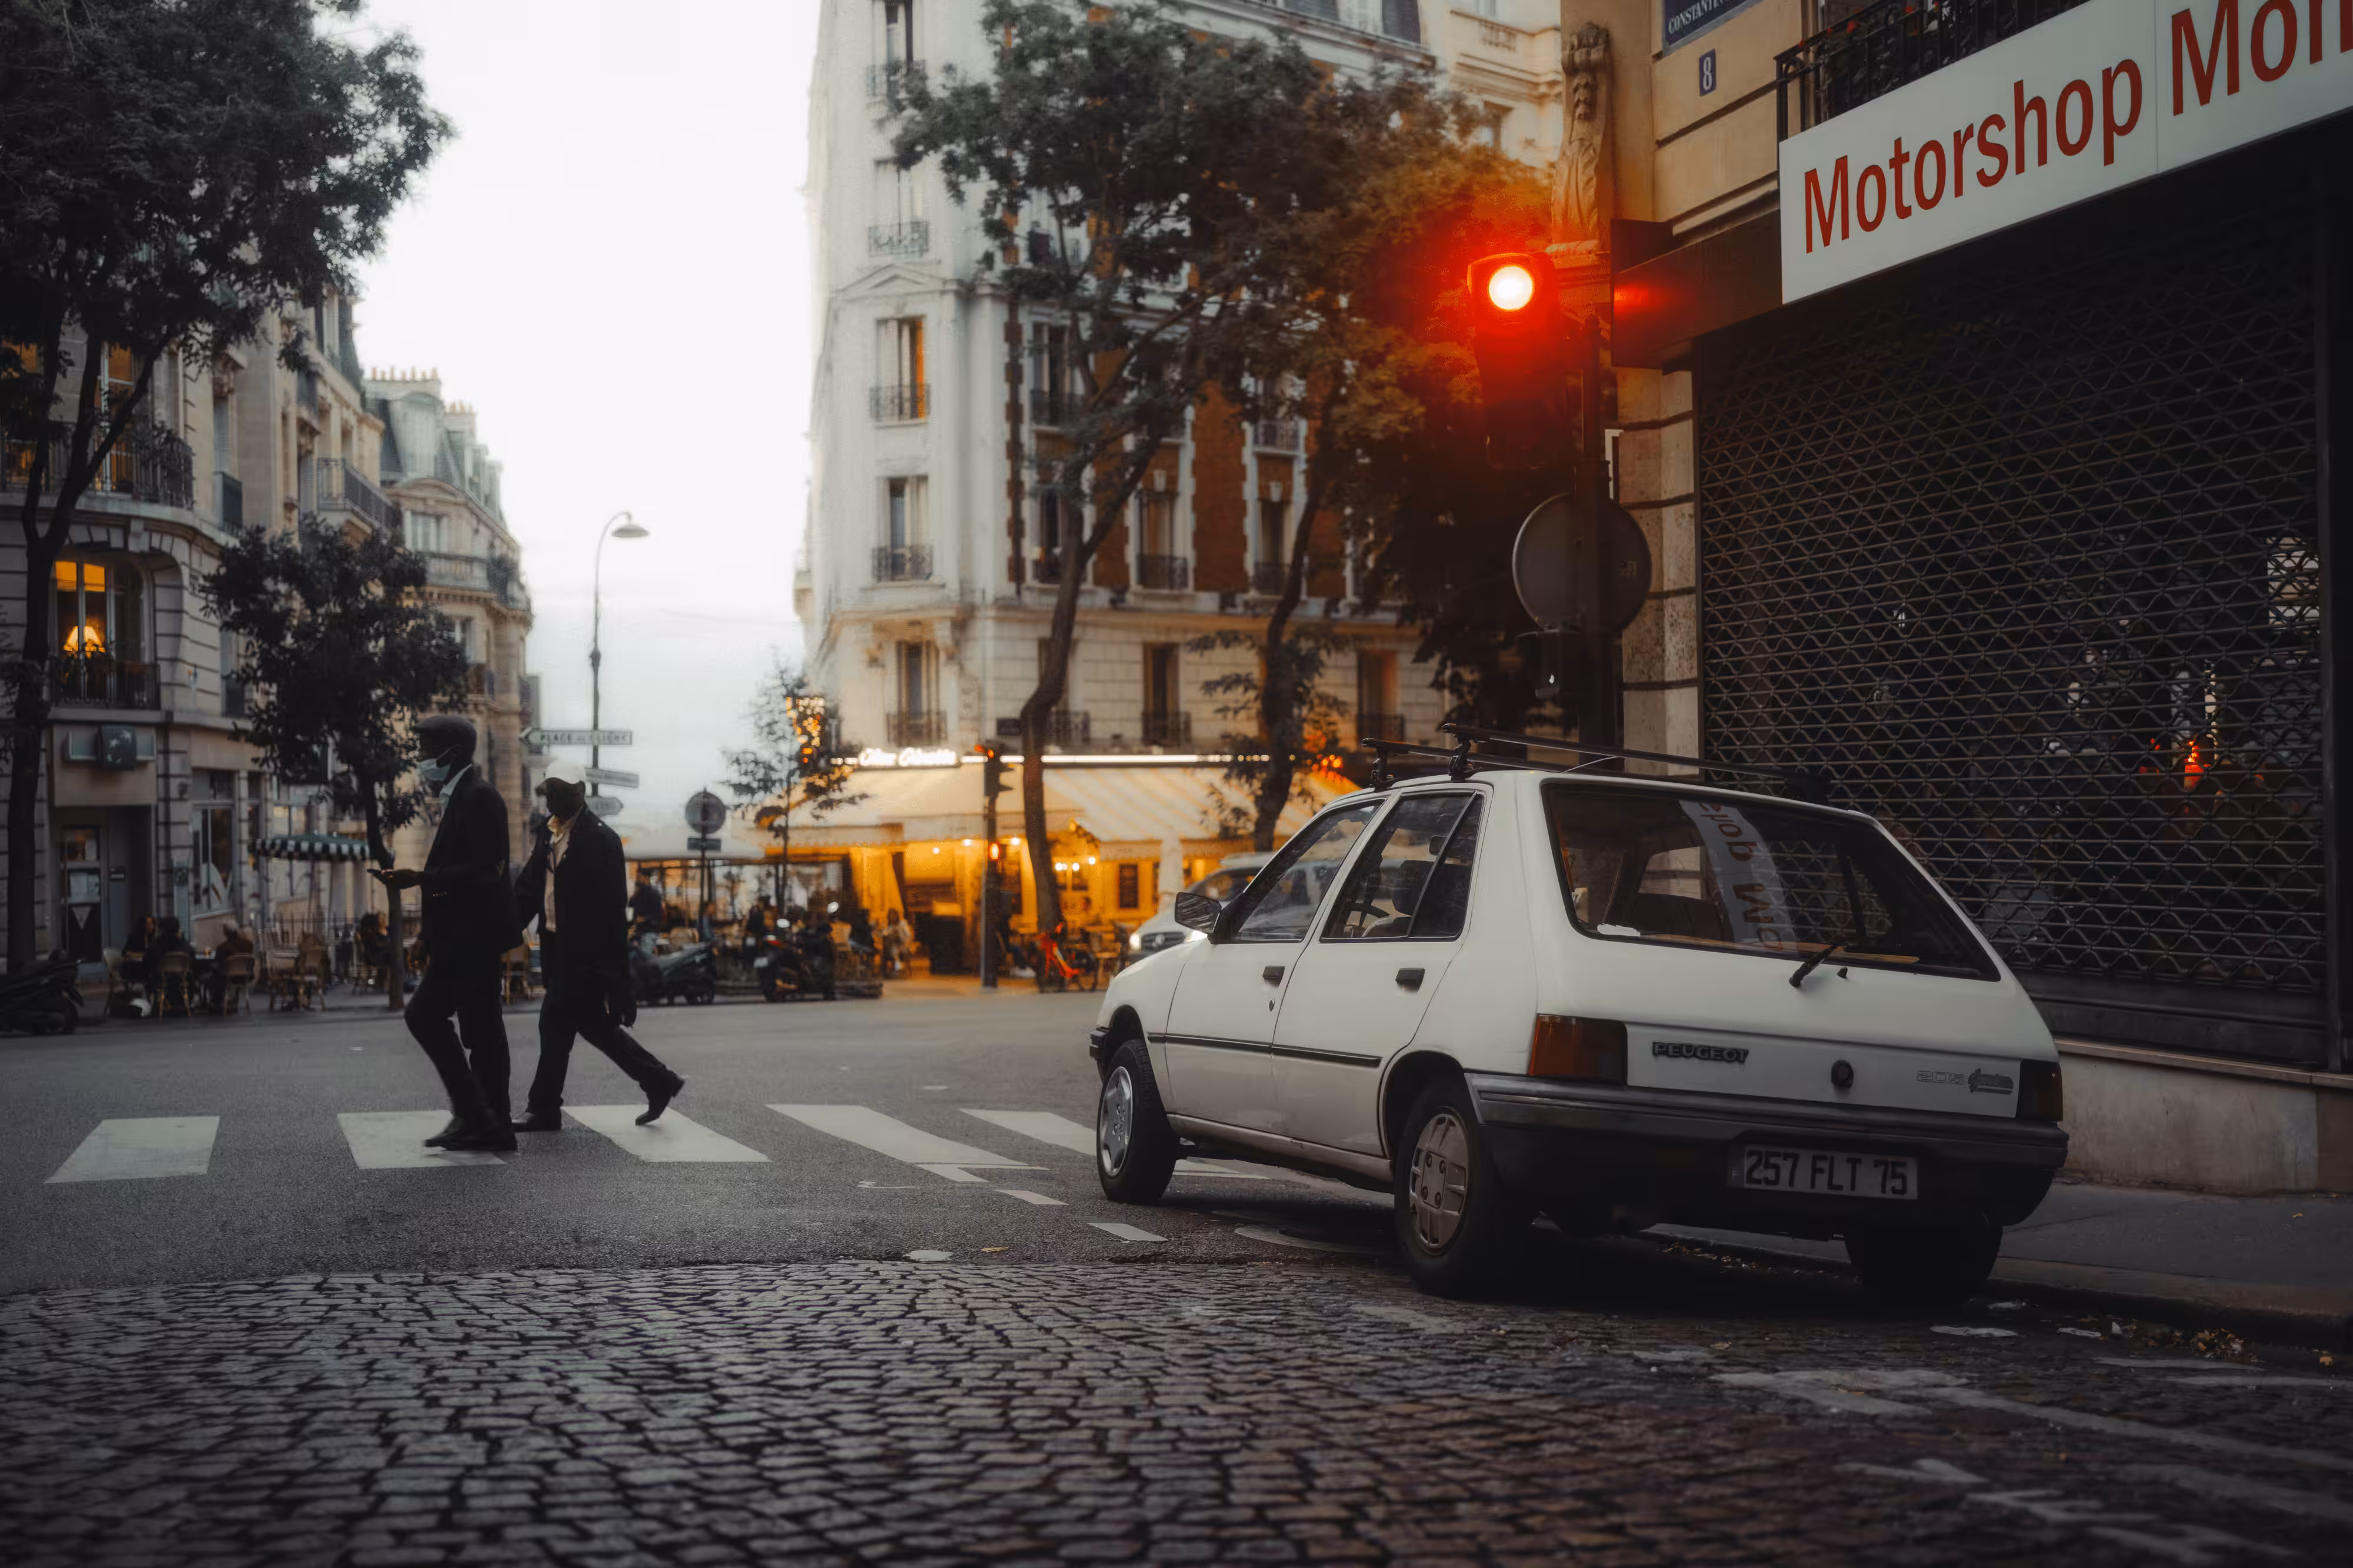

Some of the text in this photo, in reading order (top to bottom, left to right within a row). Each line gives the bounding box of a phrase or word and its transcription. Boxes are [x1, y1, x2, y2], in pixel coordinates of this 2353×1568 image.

[1703, 56, 1712, 90] 8
[1804, 57, 2143, 253] Motorshop
[1652, 1041, 1749, 1063] PEUGEOT
[1916, 1070, 1964, 1085] 205
[1745, 1149, 1801, 1188] 257
[1810, 1154, 1862, 1192] FLT
[1873, 1157, 1907, 1195] 75
